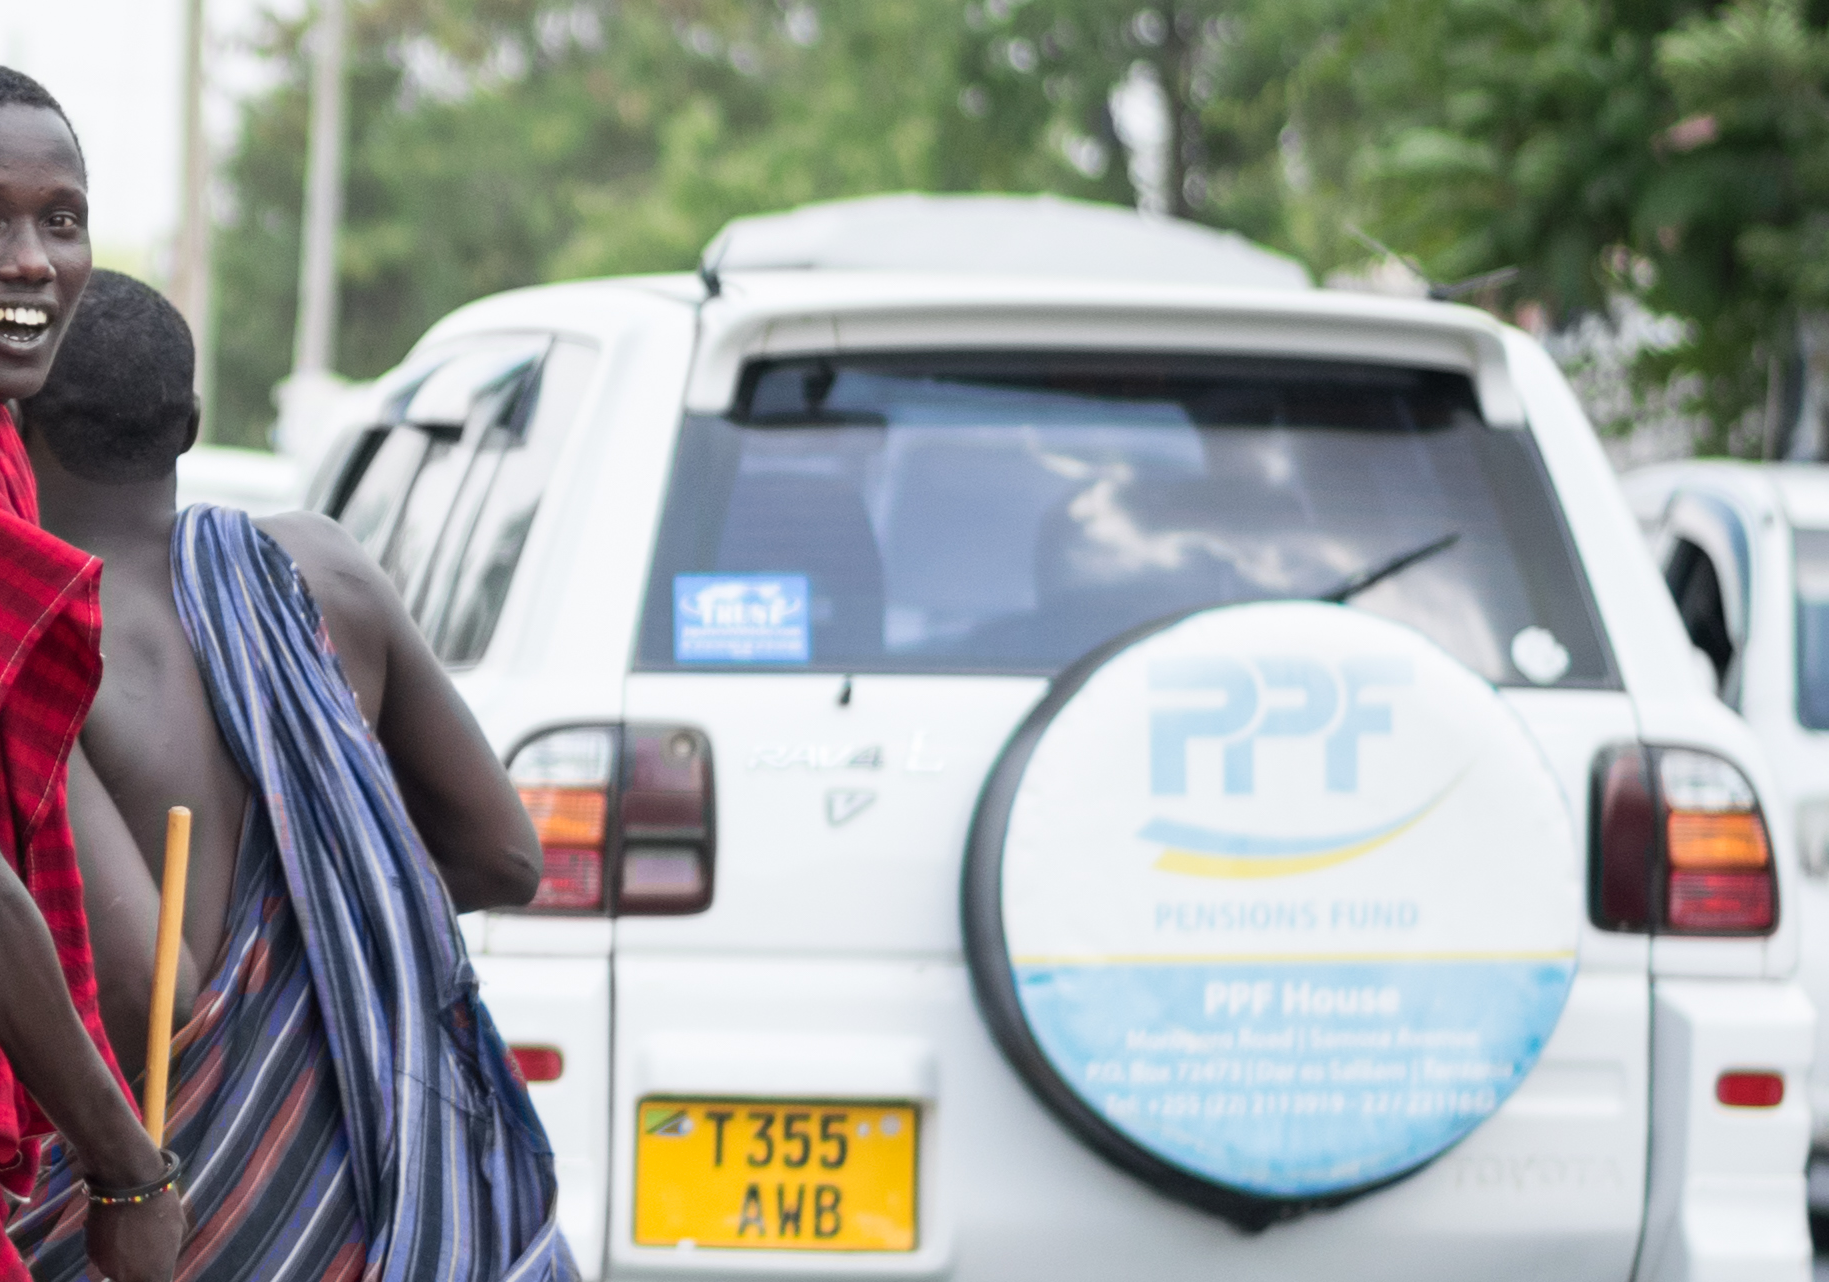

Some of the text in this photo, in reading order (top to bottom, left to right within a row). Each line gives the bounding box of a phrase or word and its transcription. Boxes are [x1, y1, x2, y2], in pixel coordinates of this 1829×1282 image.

[1147, 656, 1416, 797] PPF
[1154, 900, 1420, 933] PENSIONS FUND
[1204, 981, 1400, 1018] PPF House
[704, 1110, 849, 1169] T355
[736, 1182, 843, 1239] AWB
